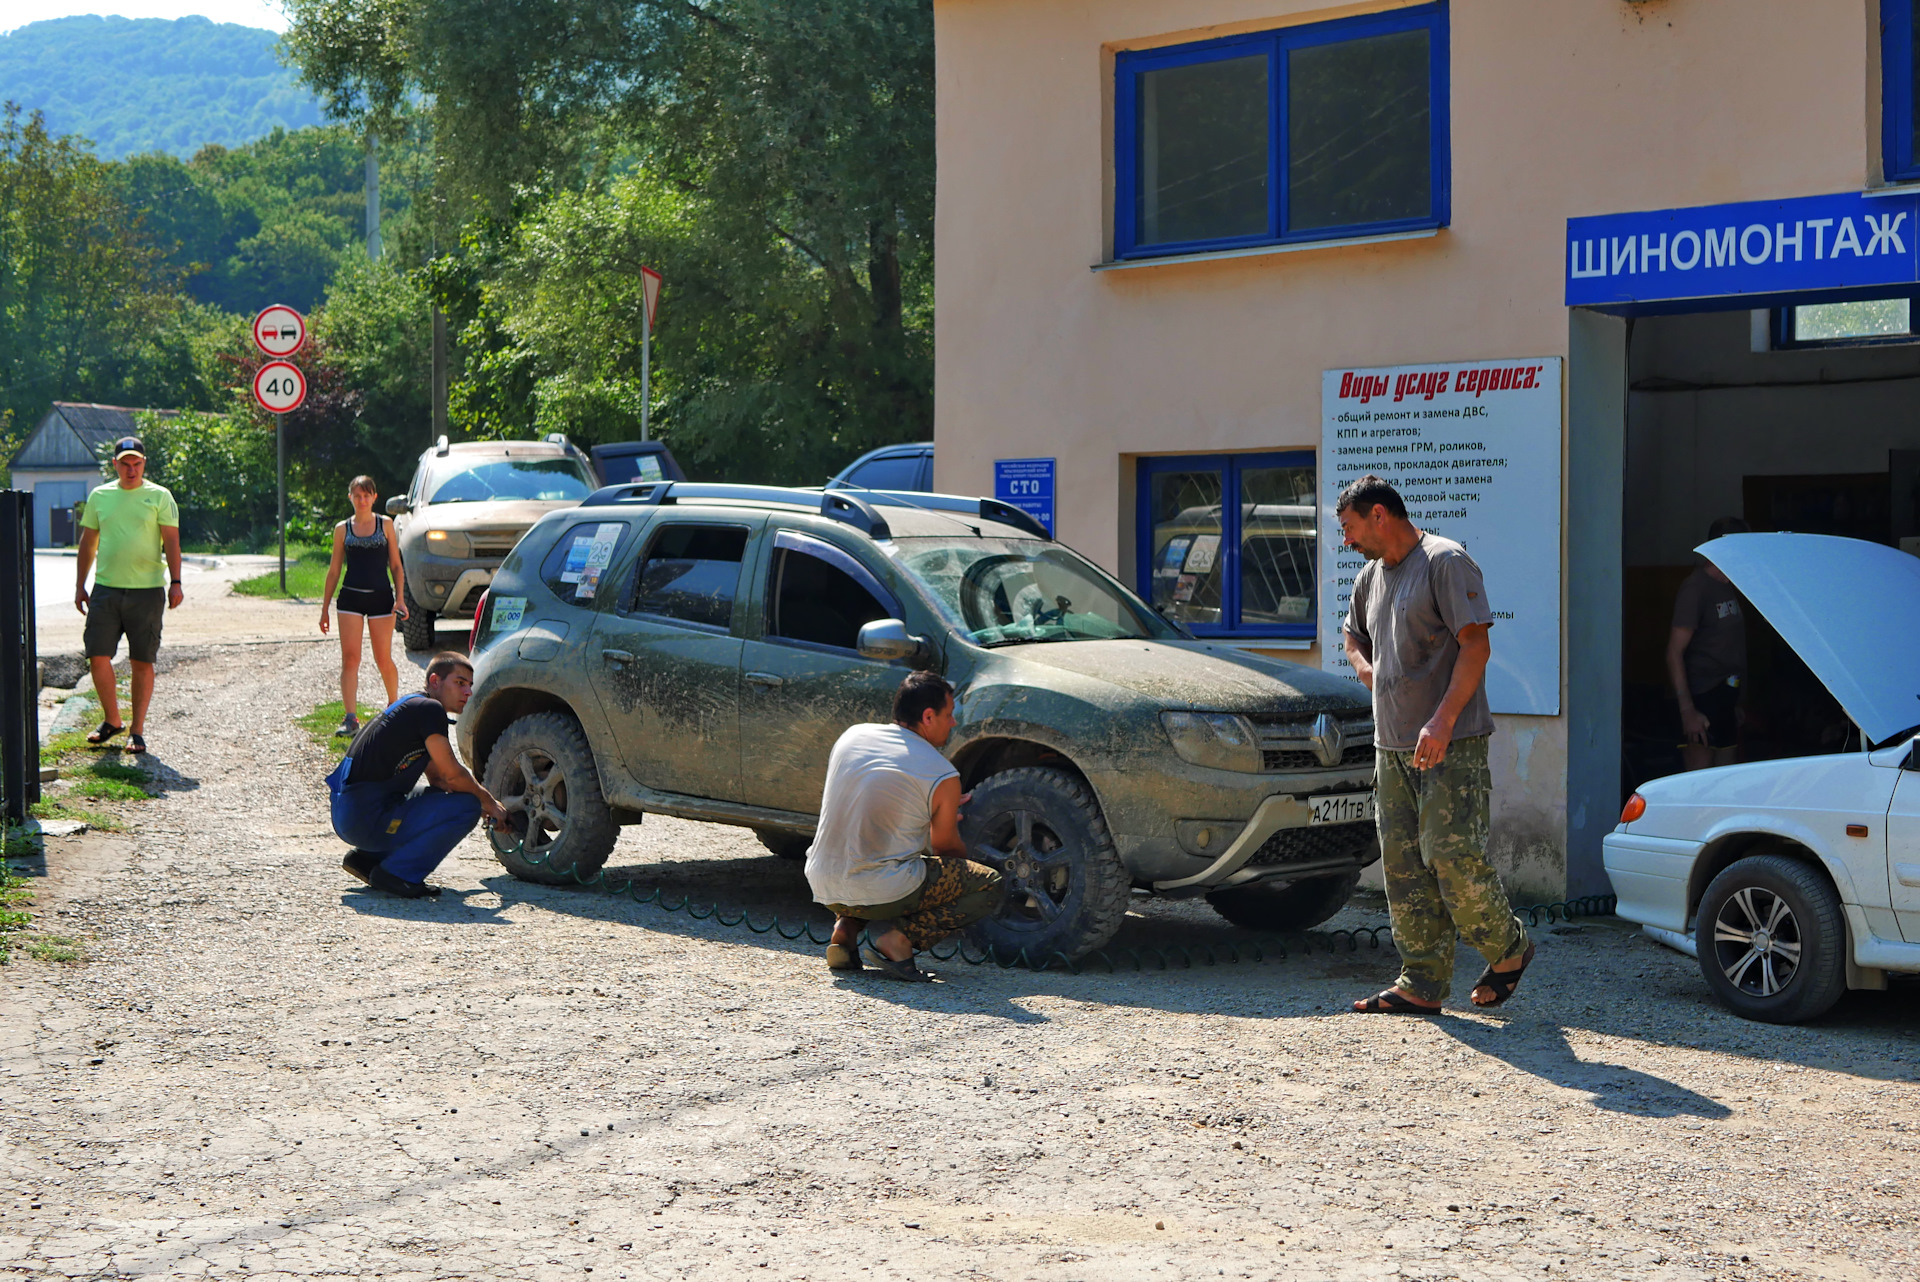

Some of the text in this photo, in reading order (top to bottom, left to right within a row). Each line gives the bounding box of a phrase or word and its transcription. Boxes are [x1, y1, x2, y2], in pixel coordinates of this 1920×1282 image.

[1571, 212, 1907, 279] ШИНОМОНТАЖ
[266, 378, 294, 396] 40
[1339, 365, 1543, 404] Виды услуг сервиса:
[1337, 406, 1489, 423] общий ремонт и замена ДВС,
[1337, 427, 1421, 439] КПП и агрегатов;
[1337, 441, 1486, 457] замена ремня ГРМ, роликов,
[1337, 456, 1508, 472] сальников, прокладок двигателя;
[1010, 480, 1039, 494] СТО
[1405, 476, 1442, 488] ремонт
[1445, 476, 1452, 485] и
[1454, 475, 1493, 485] замена
[1403, 491, 1480, 503] ходовой части;
[1425, 507, 1467, 519] деталей
[589, 542, 612, 564] 29
[507, 611, 520, 621] 009
